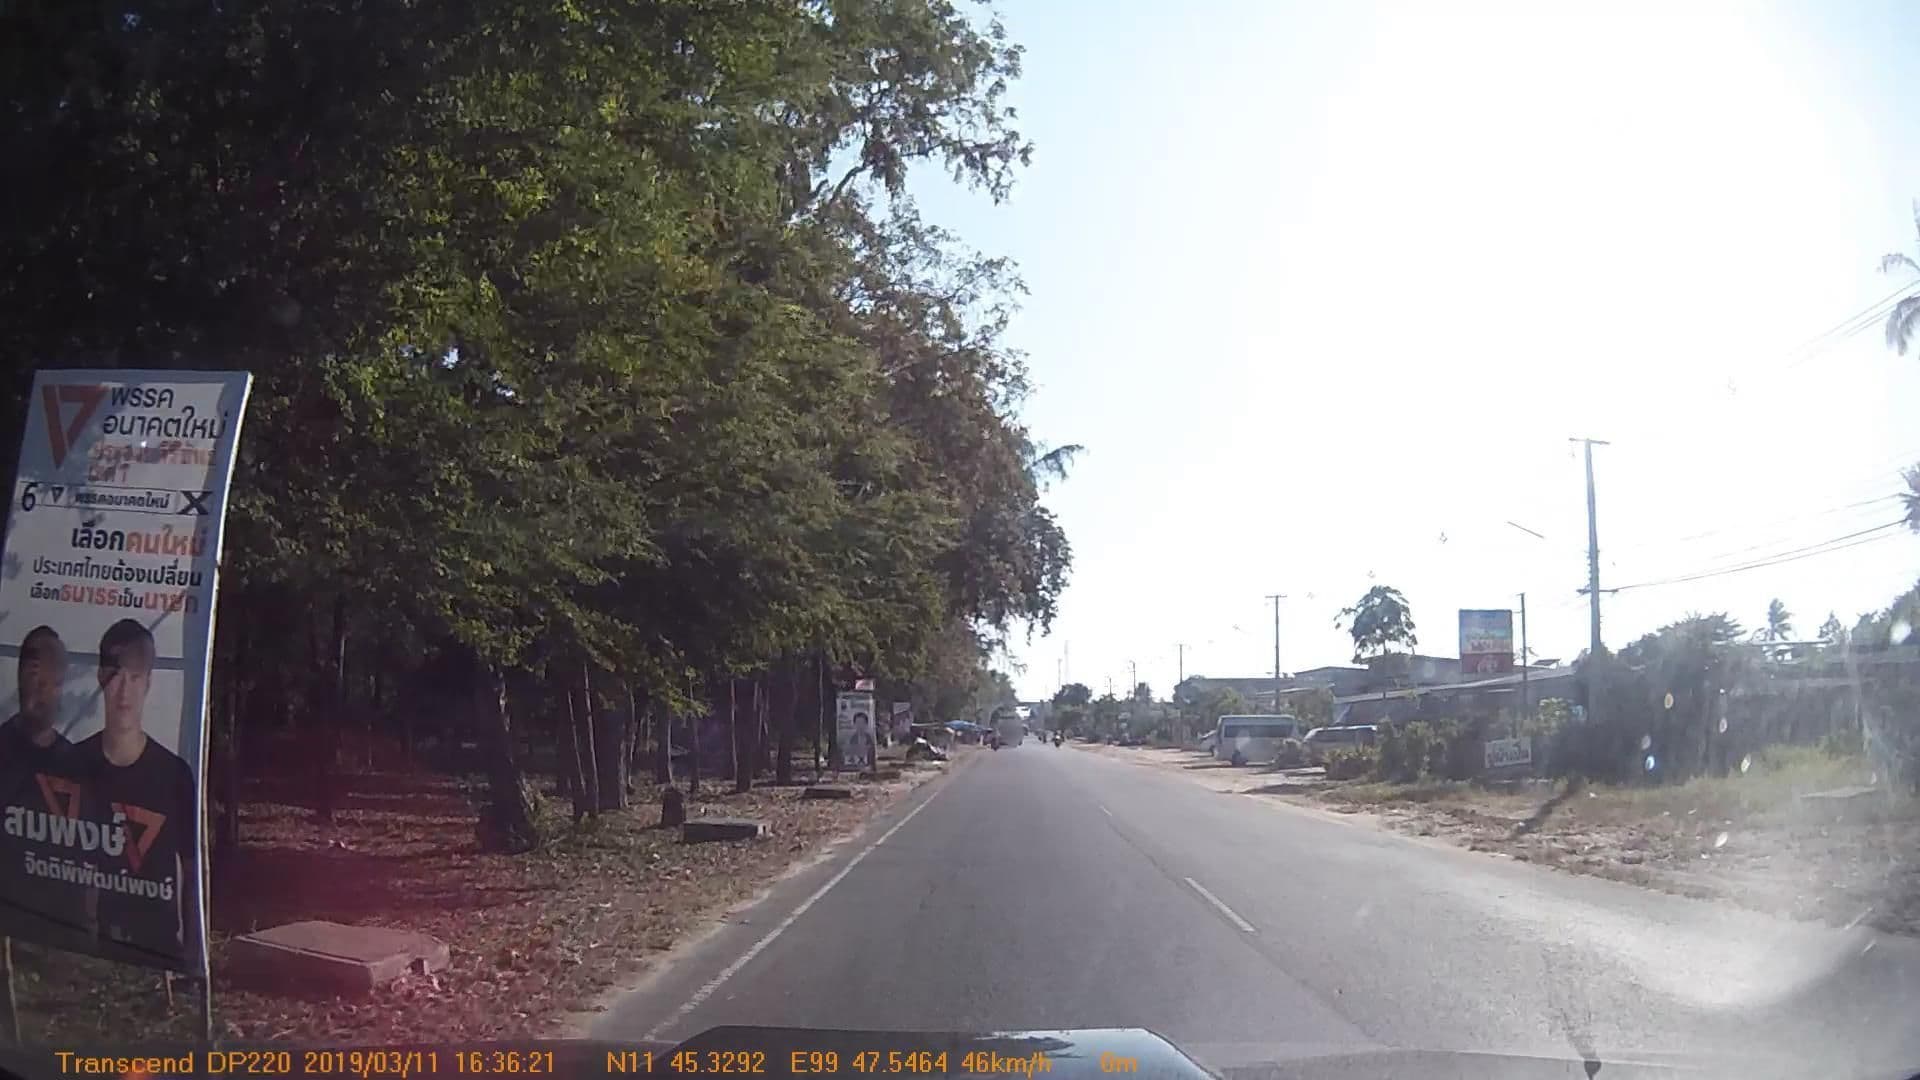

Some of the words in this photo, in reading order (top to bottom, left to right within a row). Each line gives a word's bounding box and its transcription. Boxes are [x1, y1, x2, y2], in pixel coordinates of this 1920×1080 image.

[111, 386, 174, 409] พรรค
[103, 405, 228, 439] อนาคตใหม่
[21, 482, 38, 511] 6
[33, 557, 203, 588] ประเทศไทยต้องเปลี่ยน
[4, 804, 127, 857] สมพงษ์
